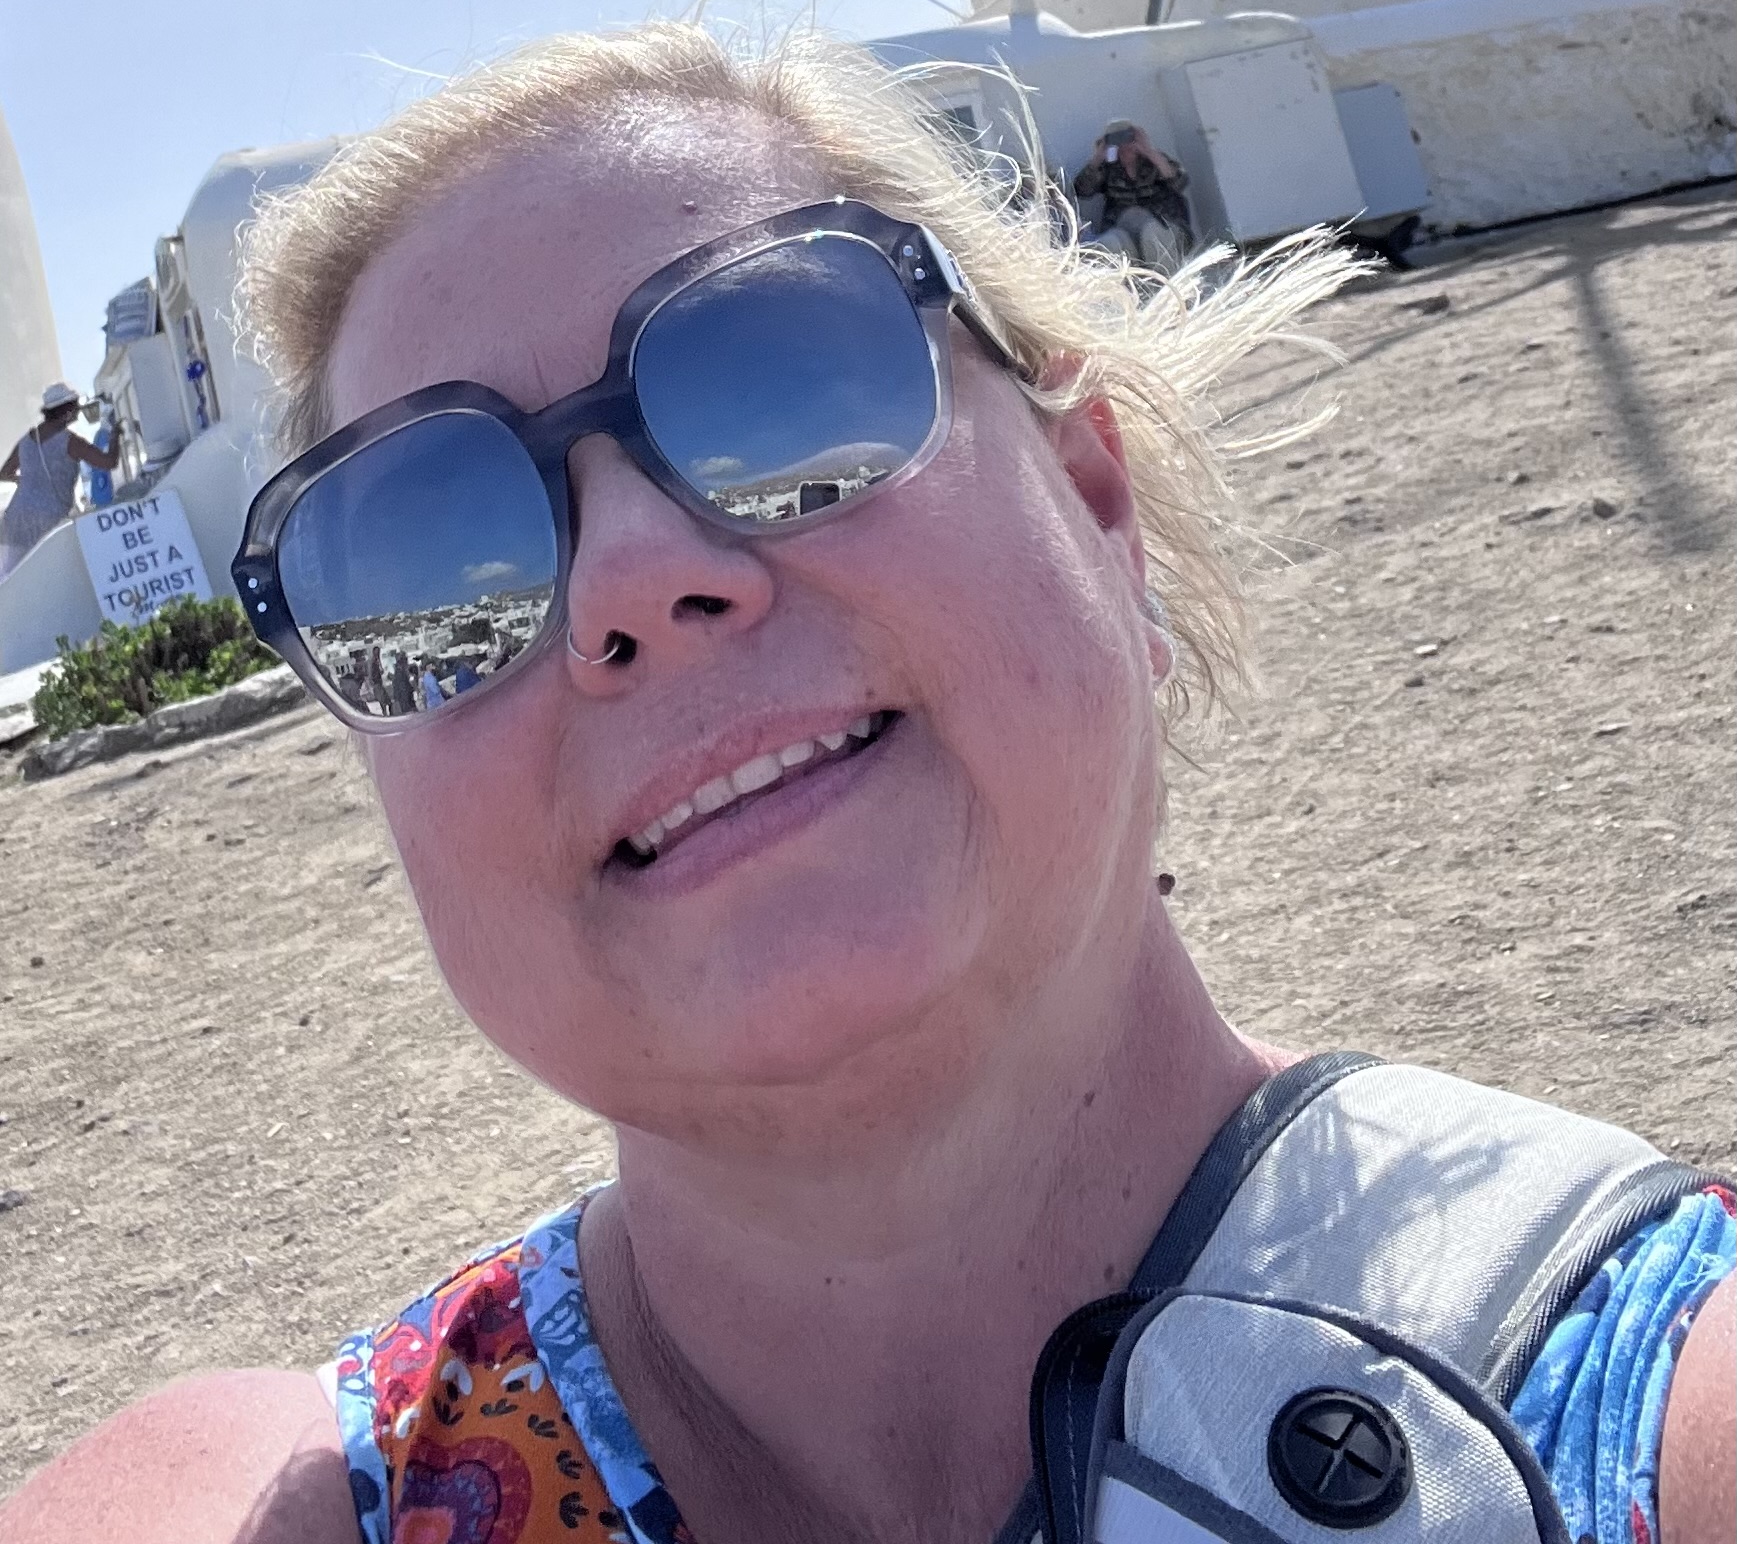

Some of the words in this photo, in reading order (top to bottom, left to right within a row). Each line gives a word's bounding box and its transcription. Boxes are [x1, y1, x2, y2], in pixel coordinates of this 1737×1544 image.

[97, 497, 159, 532] DON'T
[122, 526, 154, 550] BE
[109, 550, 159, 583] JUST
[167, 545, 183, 563] A
[104, 567, 195, 611] TOURIST
